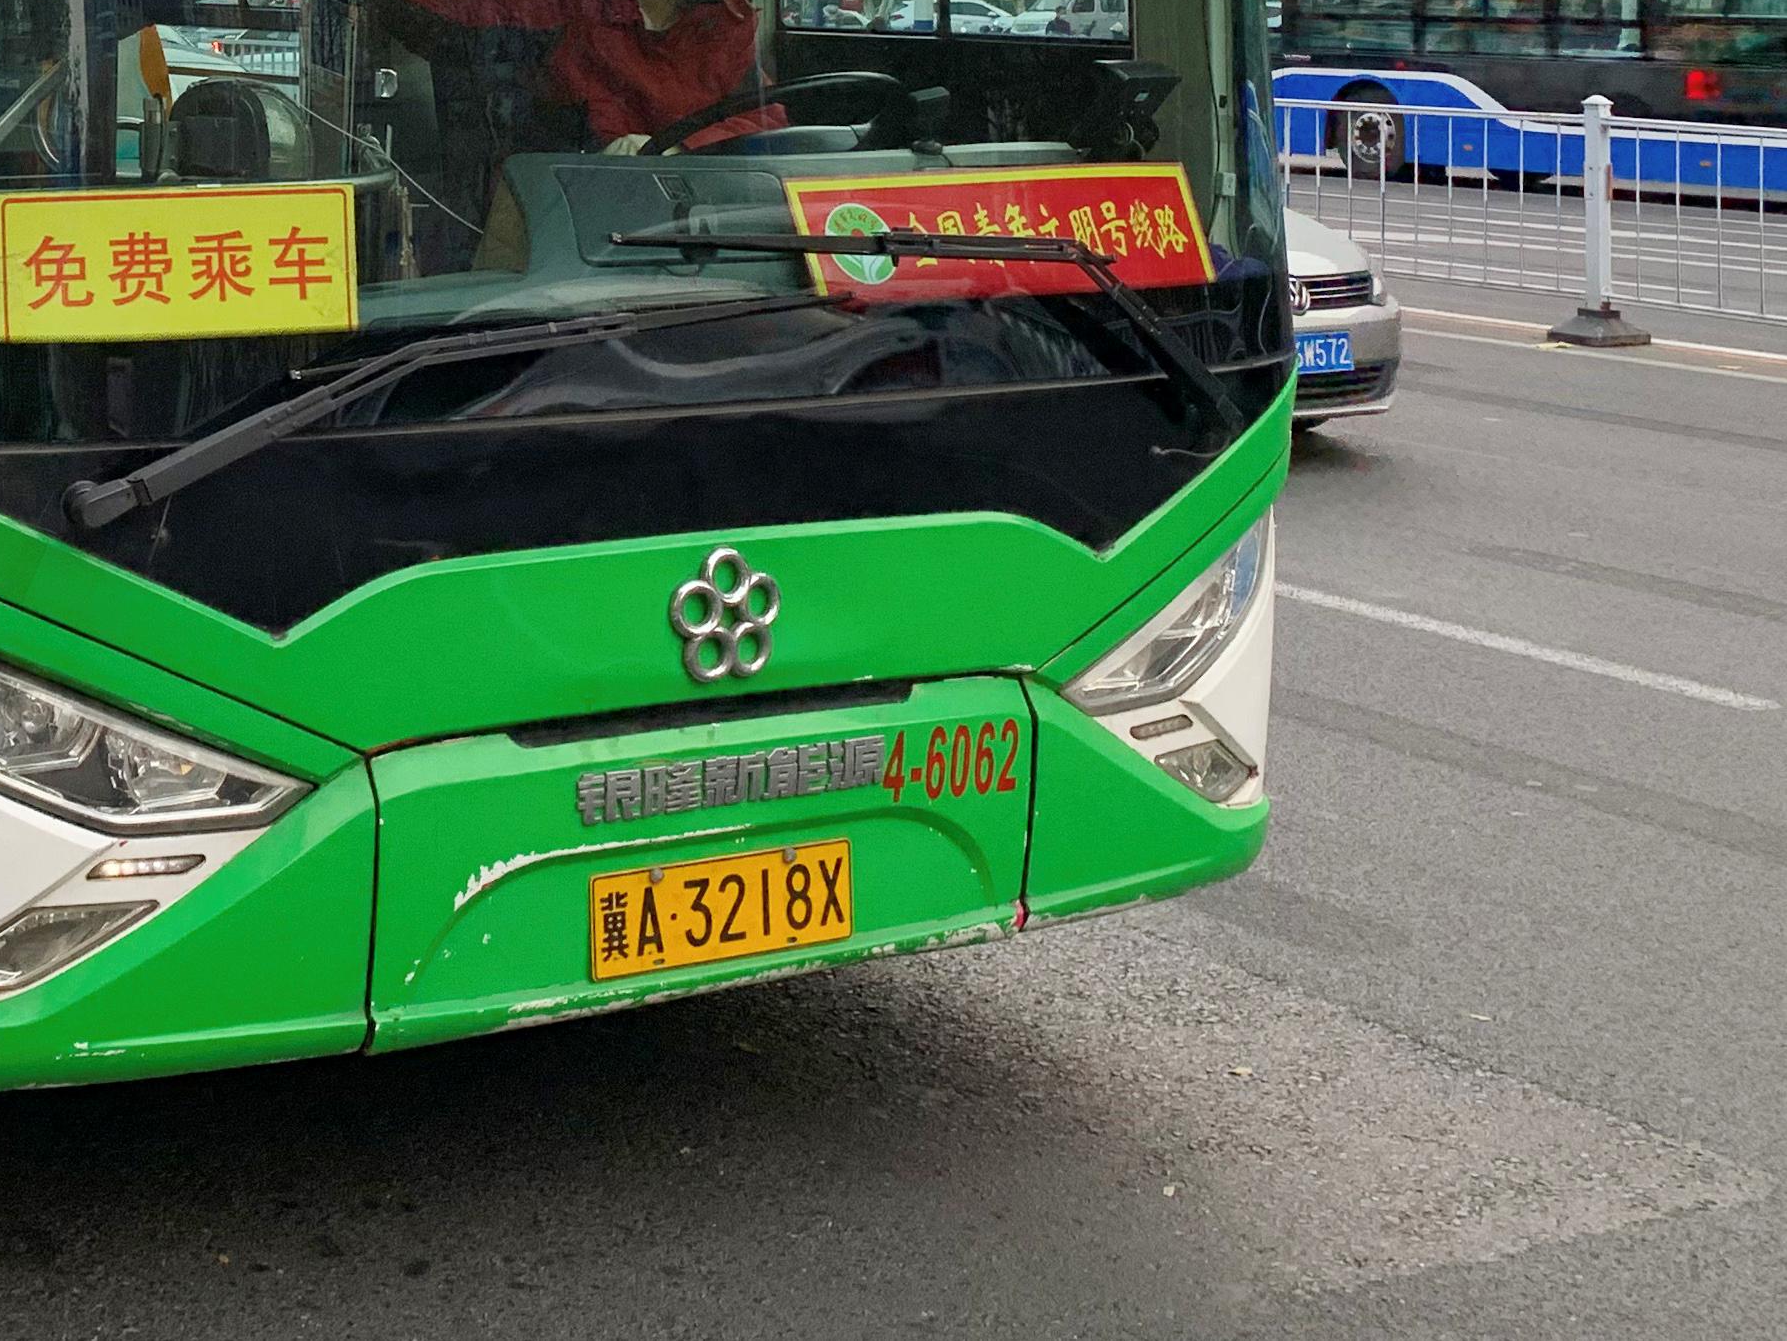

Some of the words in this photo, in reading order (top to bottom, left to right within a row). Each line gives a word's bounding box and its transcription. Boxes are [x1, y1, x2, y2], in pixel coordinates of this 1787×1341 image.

[23, 225, 334, 311] 免费乘车
[576, 734, 885, 826] 银隆新能源
[881, 717, 1020, 804] 4-6062
